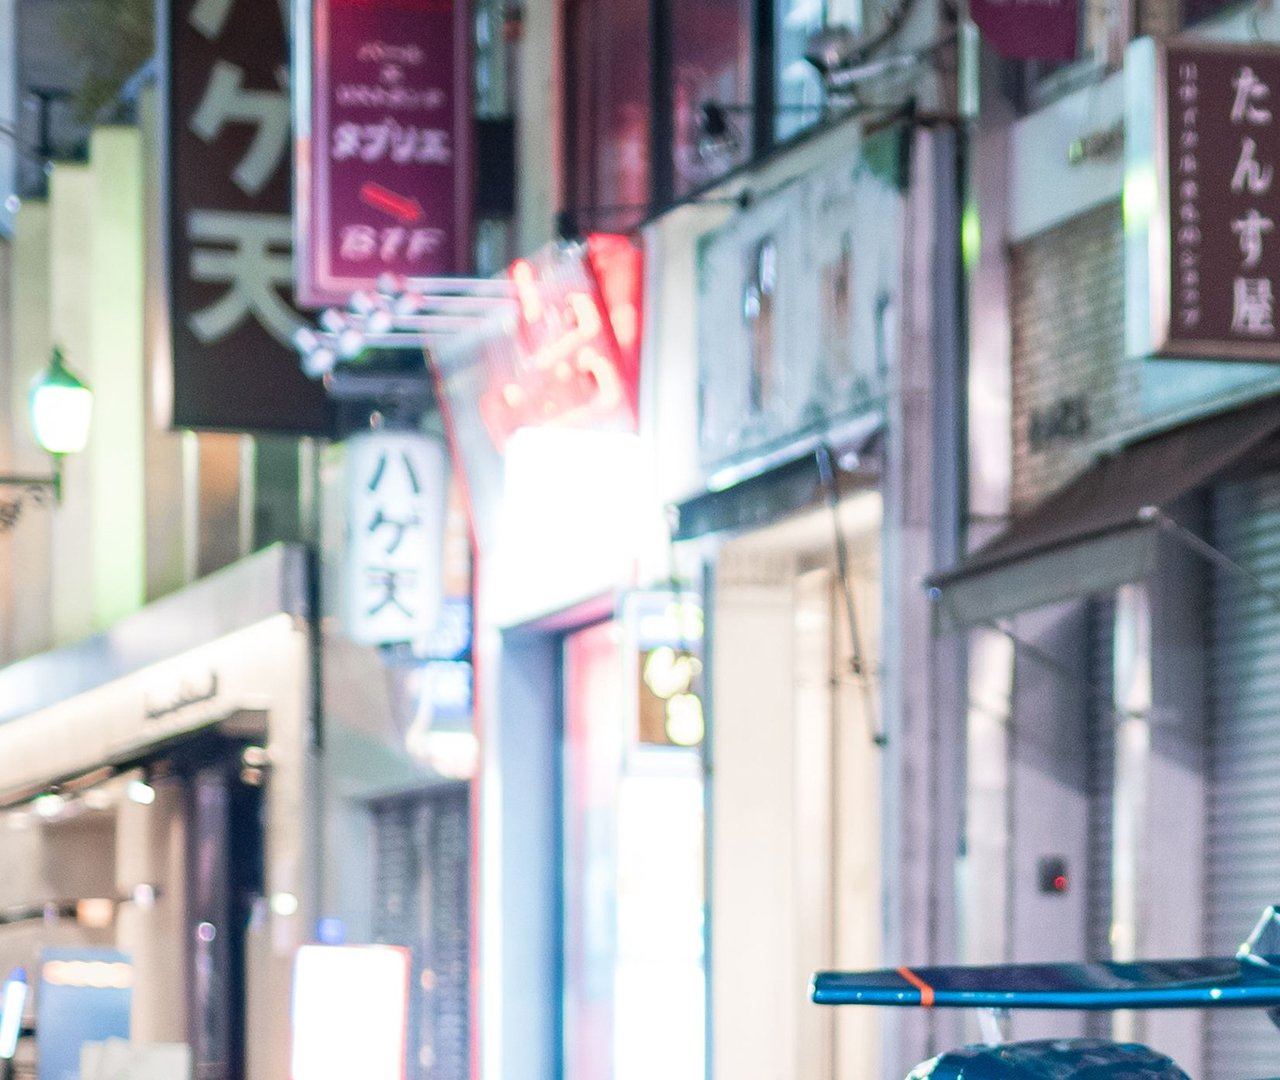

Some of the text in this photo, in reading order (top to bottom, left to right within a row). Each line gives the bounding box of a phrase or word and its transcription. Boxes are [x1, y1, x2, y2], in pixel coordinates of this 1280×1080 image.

[187, 0, 304, 350] ゲ天
[1230, 65, 1276, 337] たんす屋
[366, 454, 424, 621] ハゲ天
